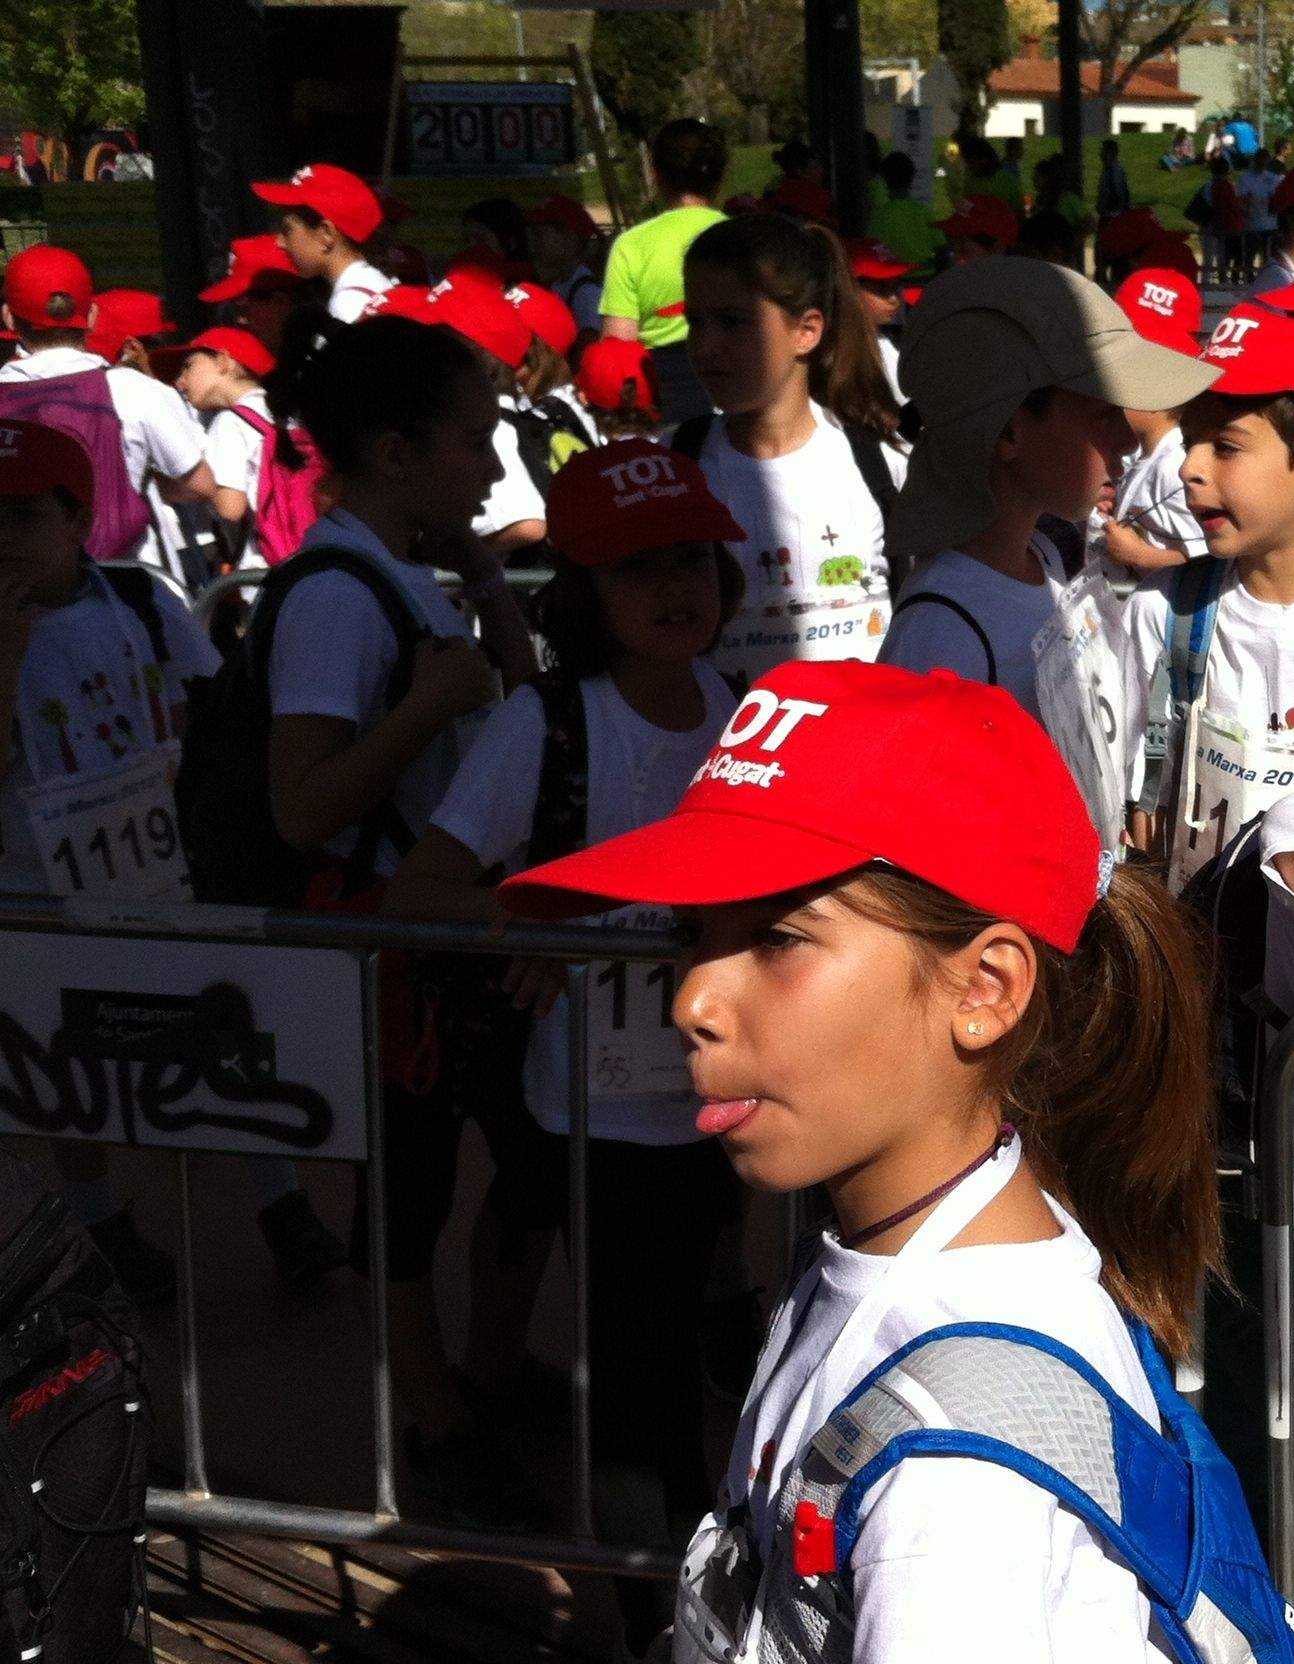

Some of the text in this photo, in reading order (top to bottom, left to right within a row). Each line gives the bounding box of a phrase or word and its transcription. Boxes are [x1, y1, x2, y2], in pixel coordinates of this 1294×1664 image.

[1144, 282, 1179, 308] TOT
[1211, 317, 1260, 344] OT
[599, 454, 677, 492] TOT
[719, 689, 829, 753] OT
[711, 753, 781, 789] Cugat
[1207, 748, 1257, 783] Marxa
[53, 807, 177, 890] 1119
[597, 960, 676, 1031] 11
